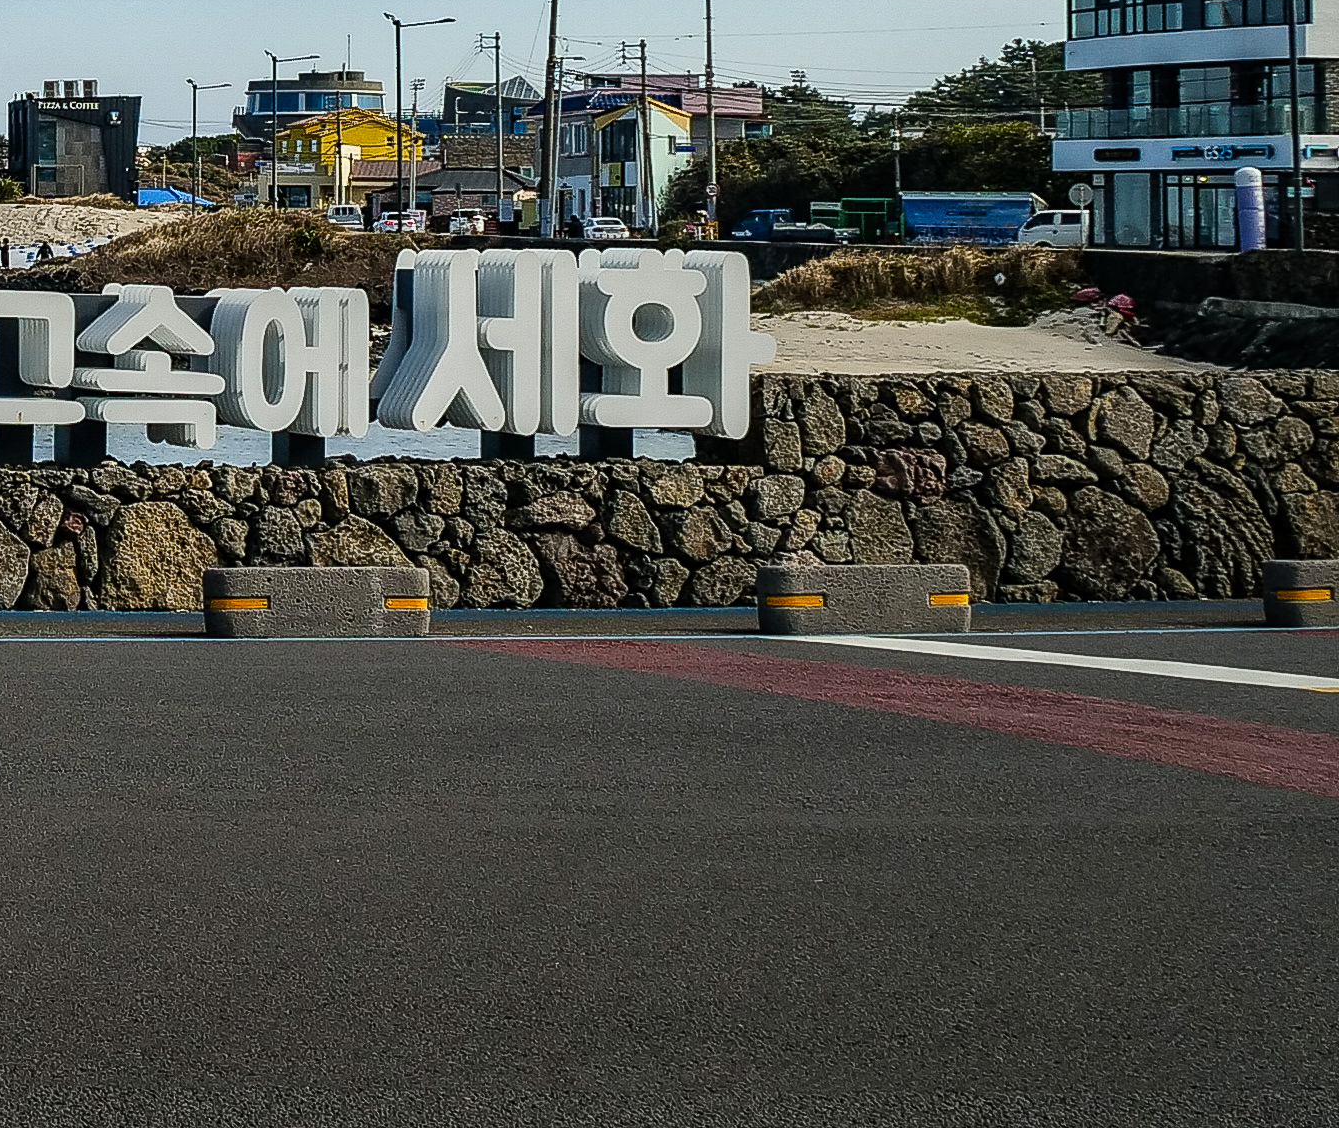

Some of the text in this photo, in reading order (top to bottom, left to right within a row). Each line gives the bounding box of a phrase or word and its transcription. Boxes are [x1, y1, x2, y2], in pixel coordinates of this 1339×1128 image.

[37, 101, 61, 110] PIZZA
[1204, 145, 1233, 160] GS25
[375, 248, 778, 441] 세화
